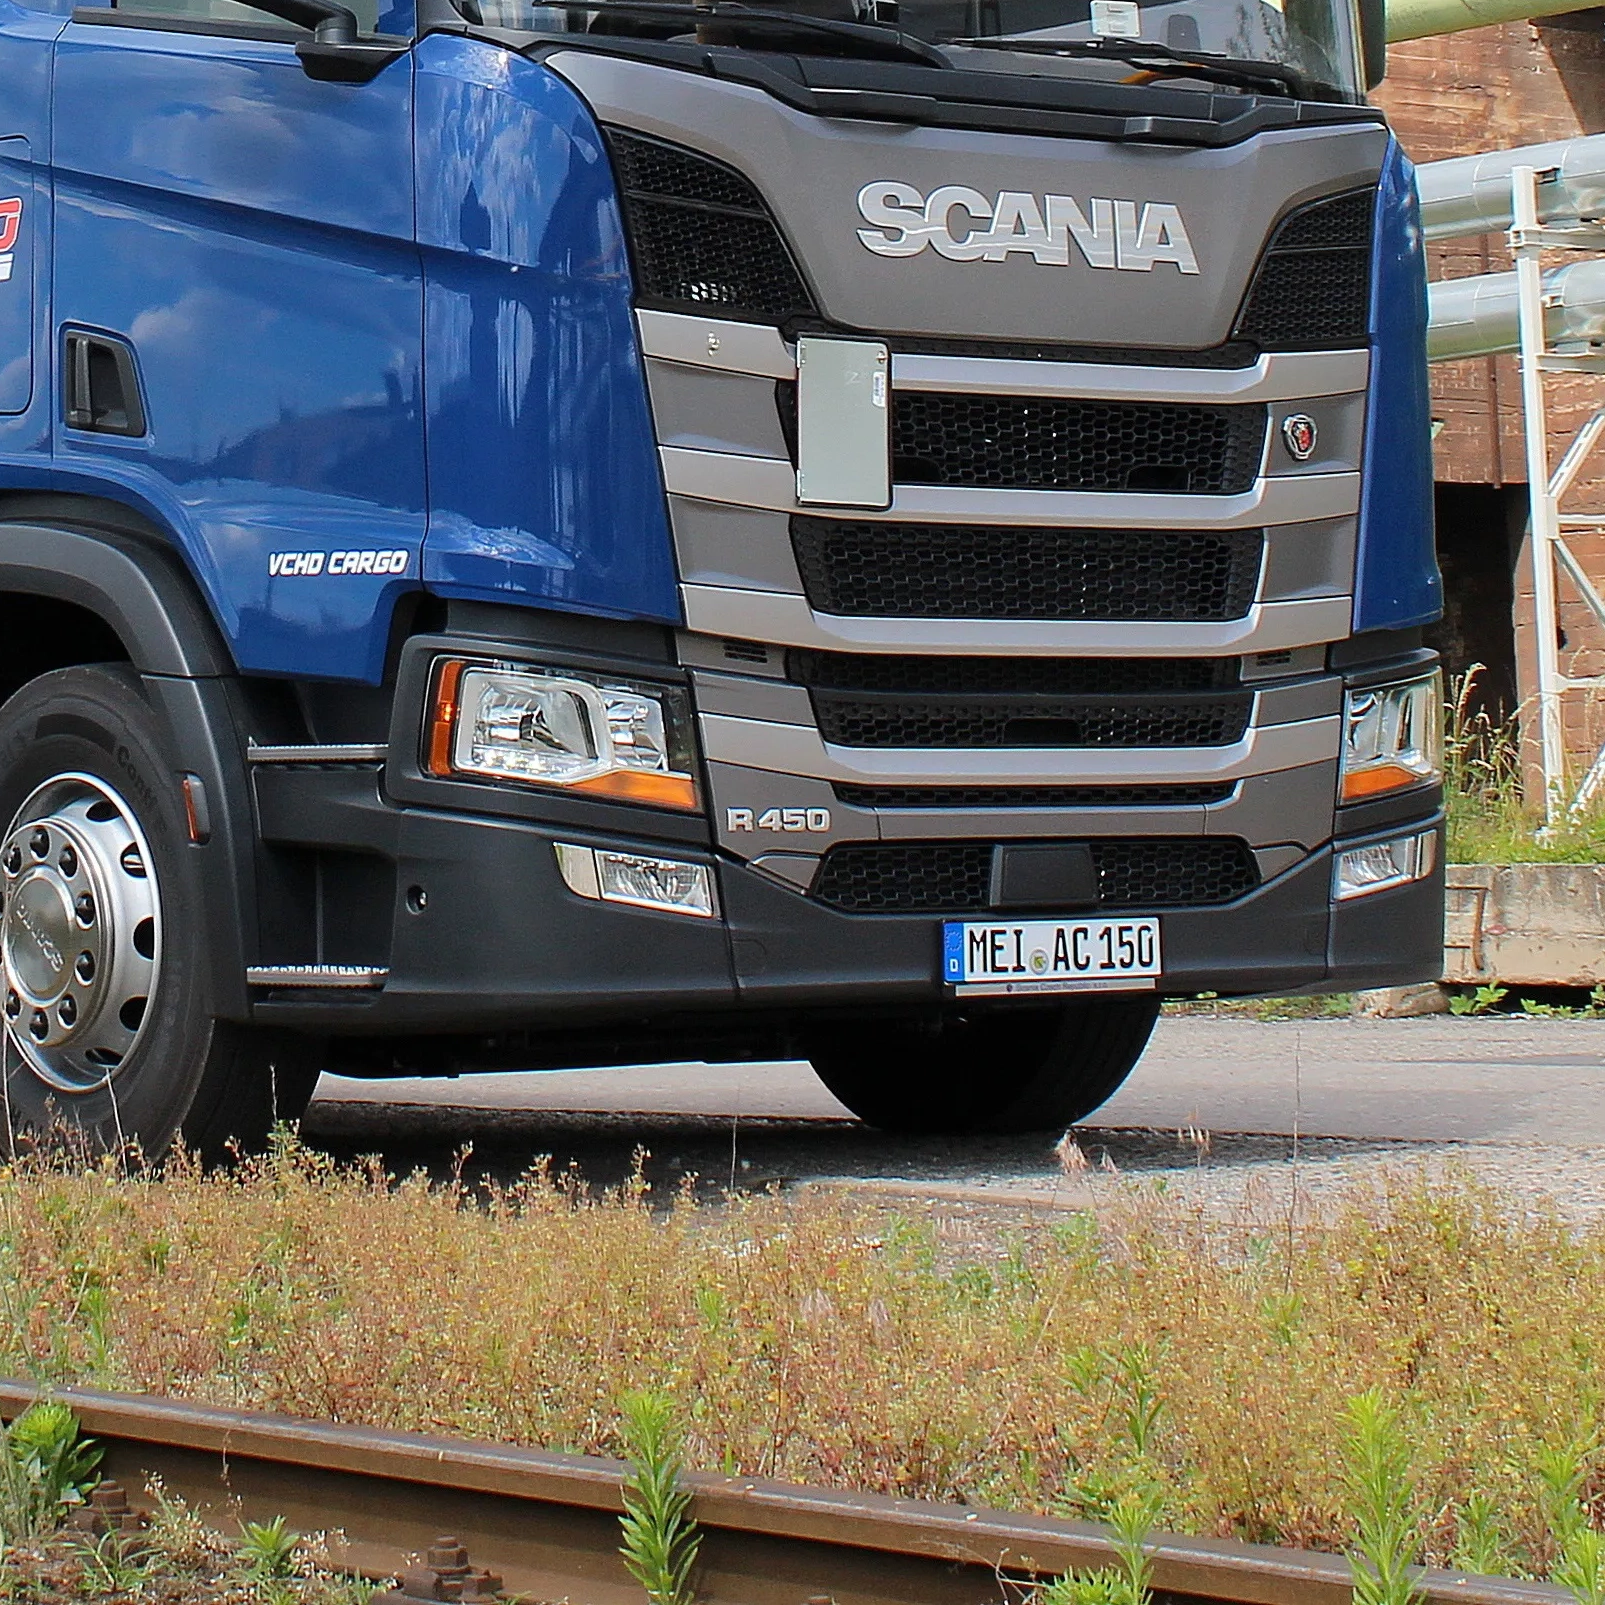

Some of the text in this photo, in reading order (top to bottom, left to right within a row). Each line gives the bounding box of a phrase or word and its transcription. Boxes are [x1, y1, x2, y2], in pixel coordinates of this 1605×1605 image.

[856, 180, 1200, 275] SCANIA
[269, 550, 409, 576] VCHD CARGO
[949, 958, 959, 973] D
[969, 929, 1026, 973] MEI
